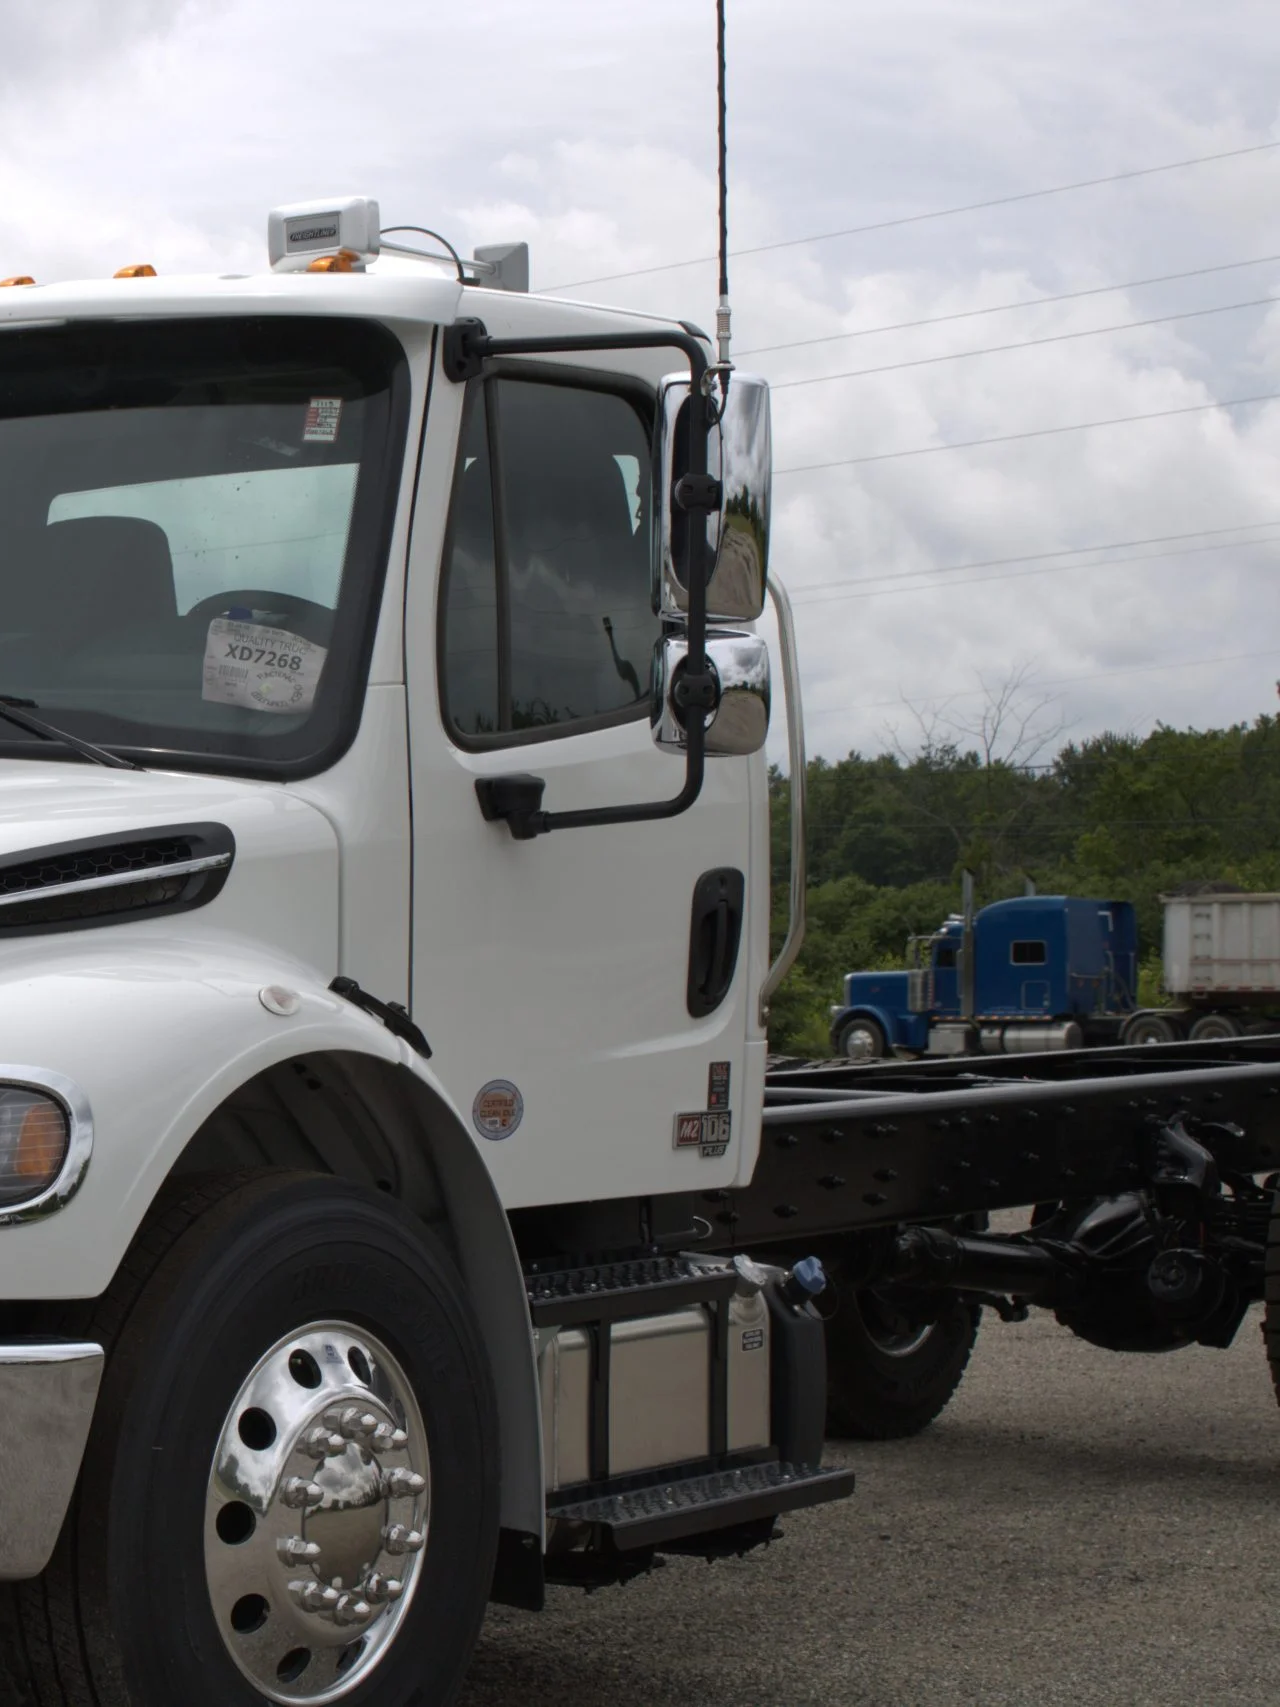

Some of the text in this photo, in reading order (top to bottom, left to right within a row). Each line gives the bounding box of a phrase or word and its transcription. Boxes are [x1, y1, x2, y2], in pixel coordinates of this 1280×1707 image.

[234, 632, 277, 648] QUALITY
[224, 643, 302, 671] XD7268
[680, 1113, 730, 1142] M2 106
